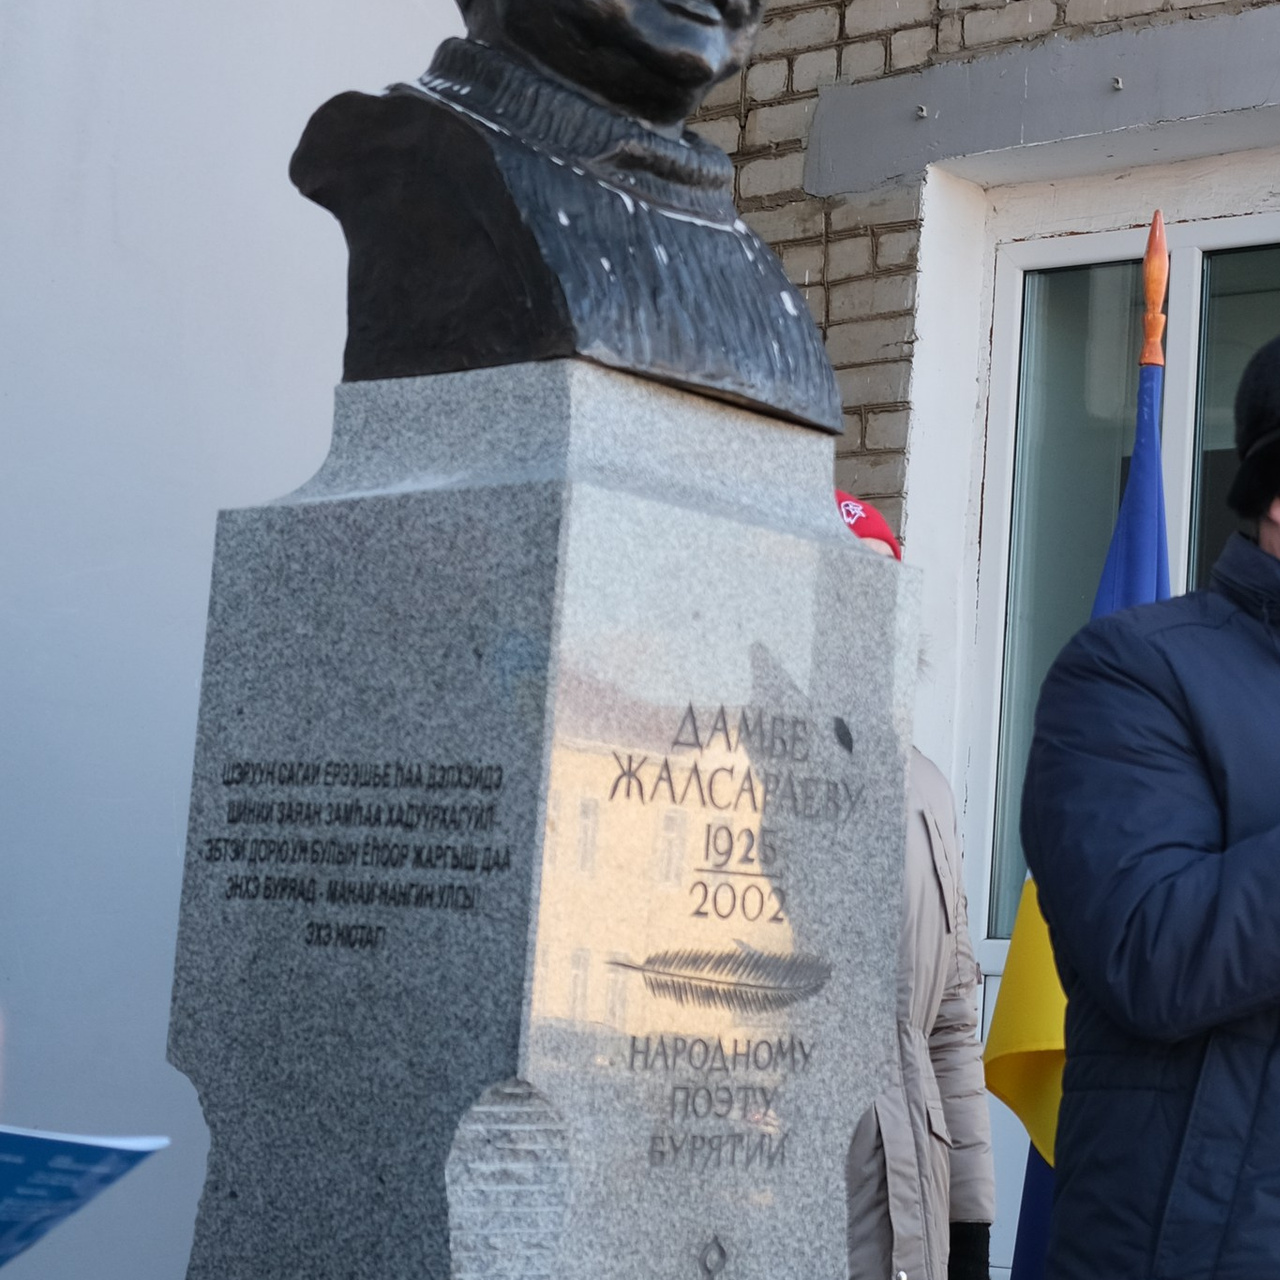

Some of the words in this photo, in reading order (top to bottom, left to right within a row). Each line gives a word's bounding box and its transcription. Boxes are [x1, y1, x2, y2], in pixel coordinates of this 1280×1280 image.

[671, 702, 810, 763] ДАМБЕ
[608, 751, 866, 822] ЖАЛСАРАЕВУ
[703, 823, 780, 868] 1925
[689, 880, 787, 923] 2002
[630, 1033, 816, 1079] НАРОДНОМУ
[671, 1086, 778, 1121] ПОЭТУ
[651, 1131, 791, 1169] БУРЯТИИ
